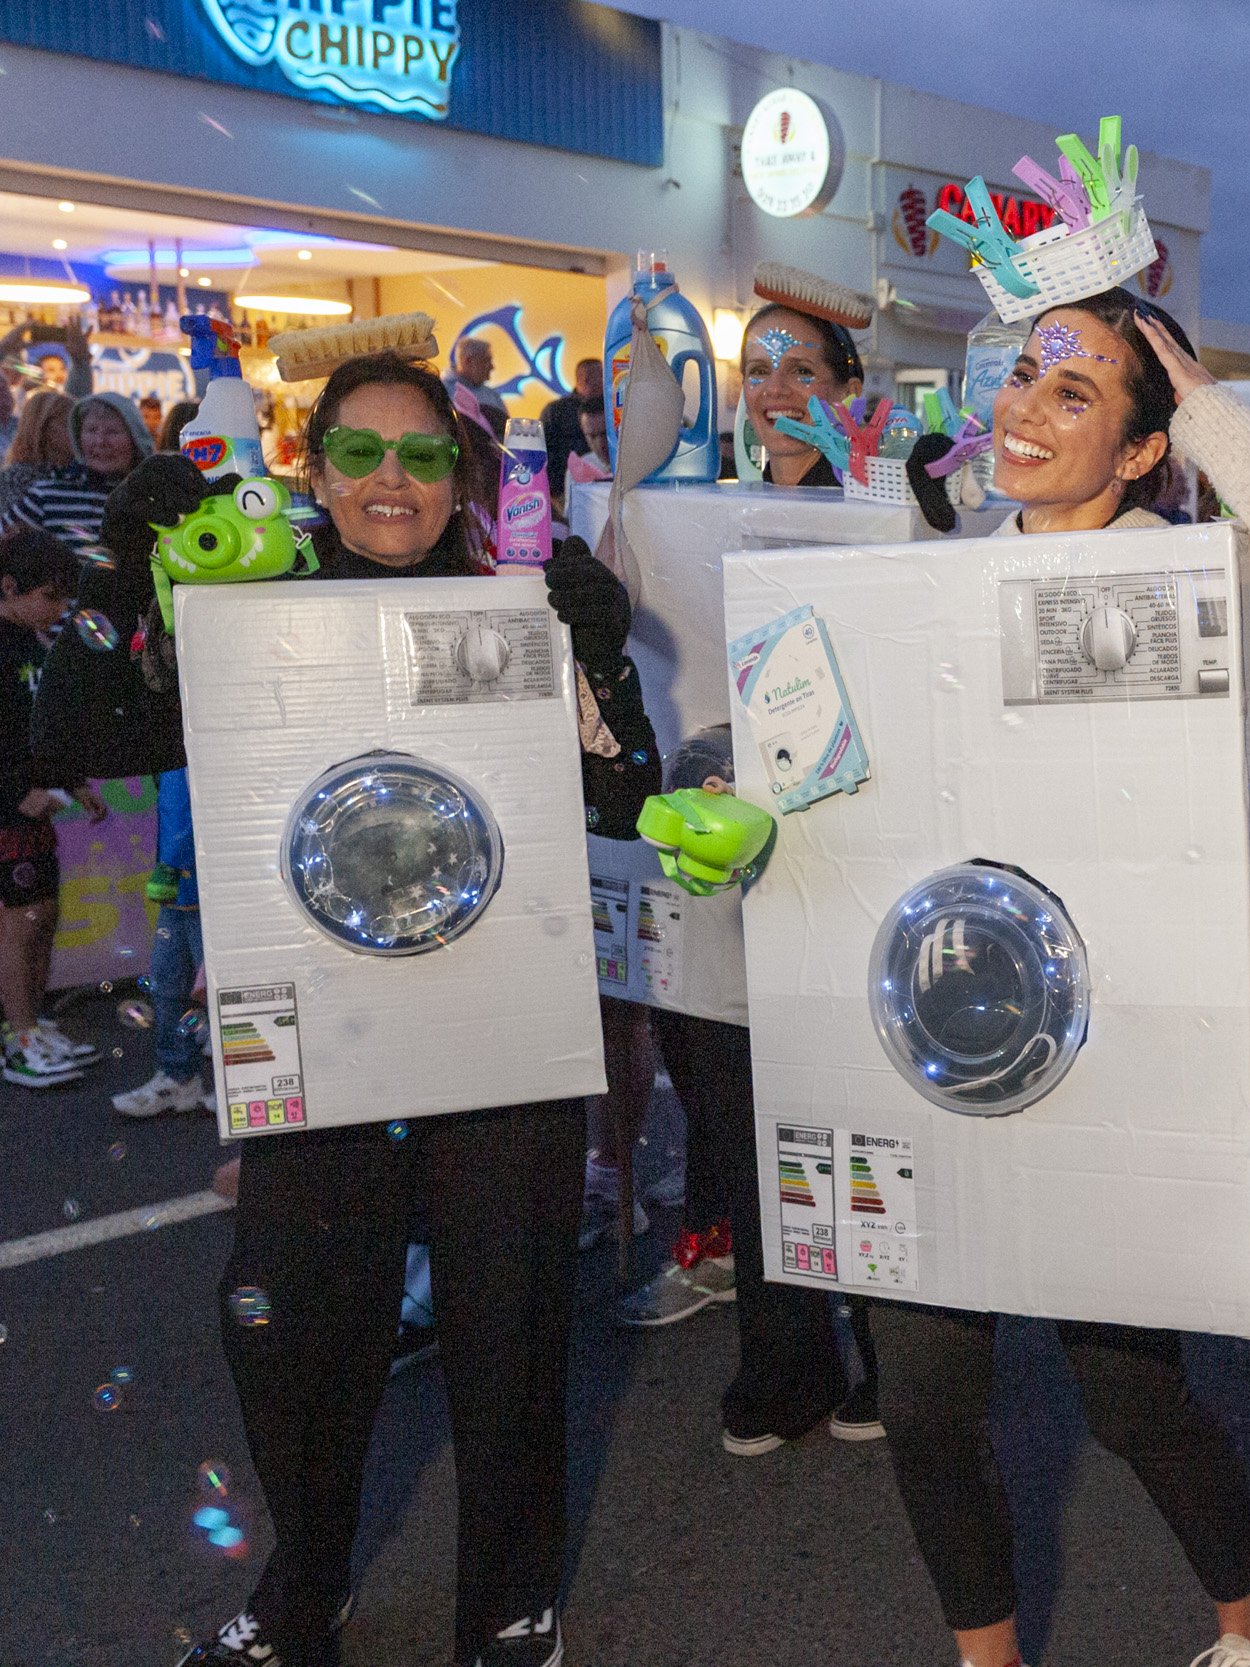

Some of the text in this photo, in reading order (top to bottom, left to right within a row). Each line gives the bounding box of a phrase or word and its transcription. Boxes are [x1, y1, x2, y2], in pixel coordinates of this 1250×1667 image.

[285, 20, 456, 81] CHIPPY
[505, 498, 540, 521] Vanish
[805, 627, 813, 636] 40
[772, 676, 812, 701] Natulim
[768, 698, 795, 715] Detergente
[802, 690, 814, 699] Tiras
[277, 1078, 294, 1087] 238
[866, 1137, 896, 1149] ENERG
[860, 1221, 876, 1229] XYZ
[816, 1227, 829, 1236] 238
